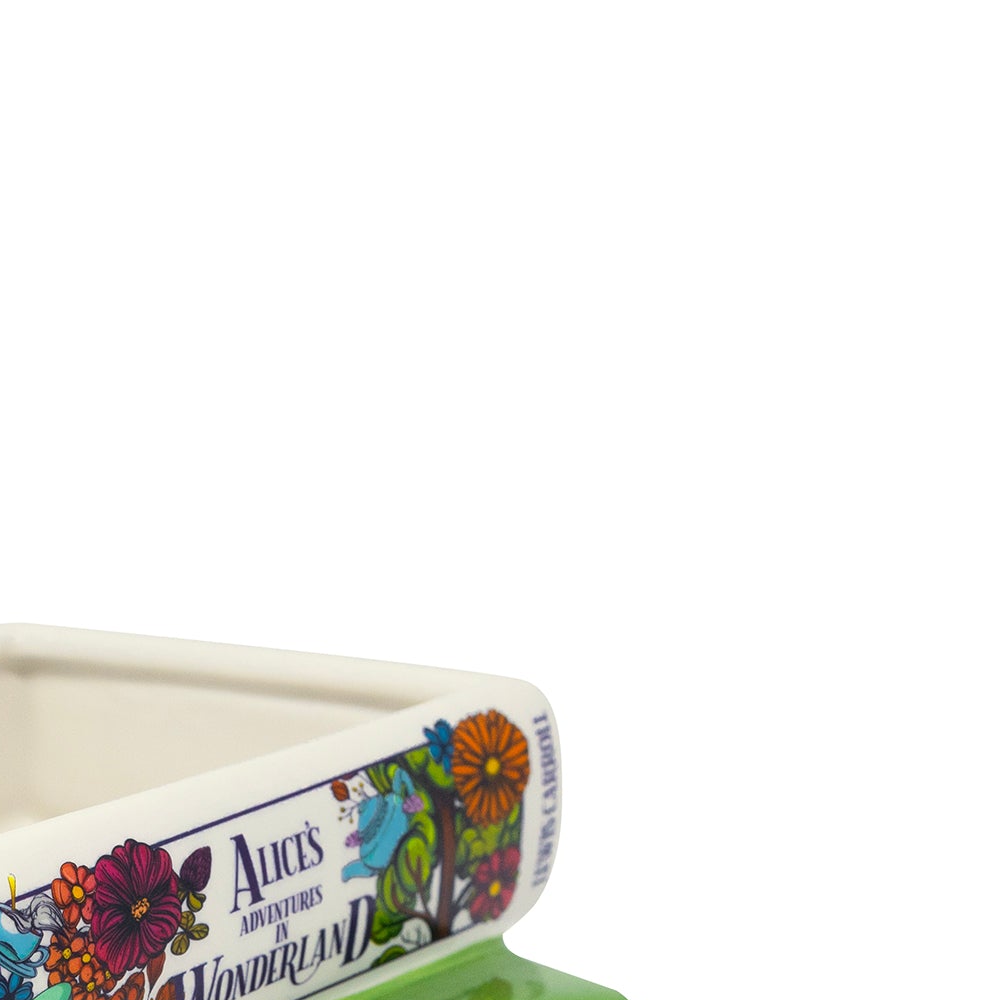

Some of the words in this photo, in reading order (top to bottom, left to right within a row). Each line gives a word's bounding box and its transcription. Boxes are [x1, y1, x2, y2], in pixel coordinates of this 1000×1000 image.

[229, 820, 324, 914] ALICE'S
[240, 884, 323, 936] ADVENTURES
[275, 920, 289, 944] IN
